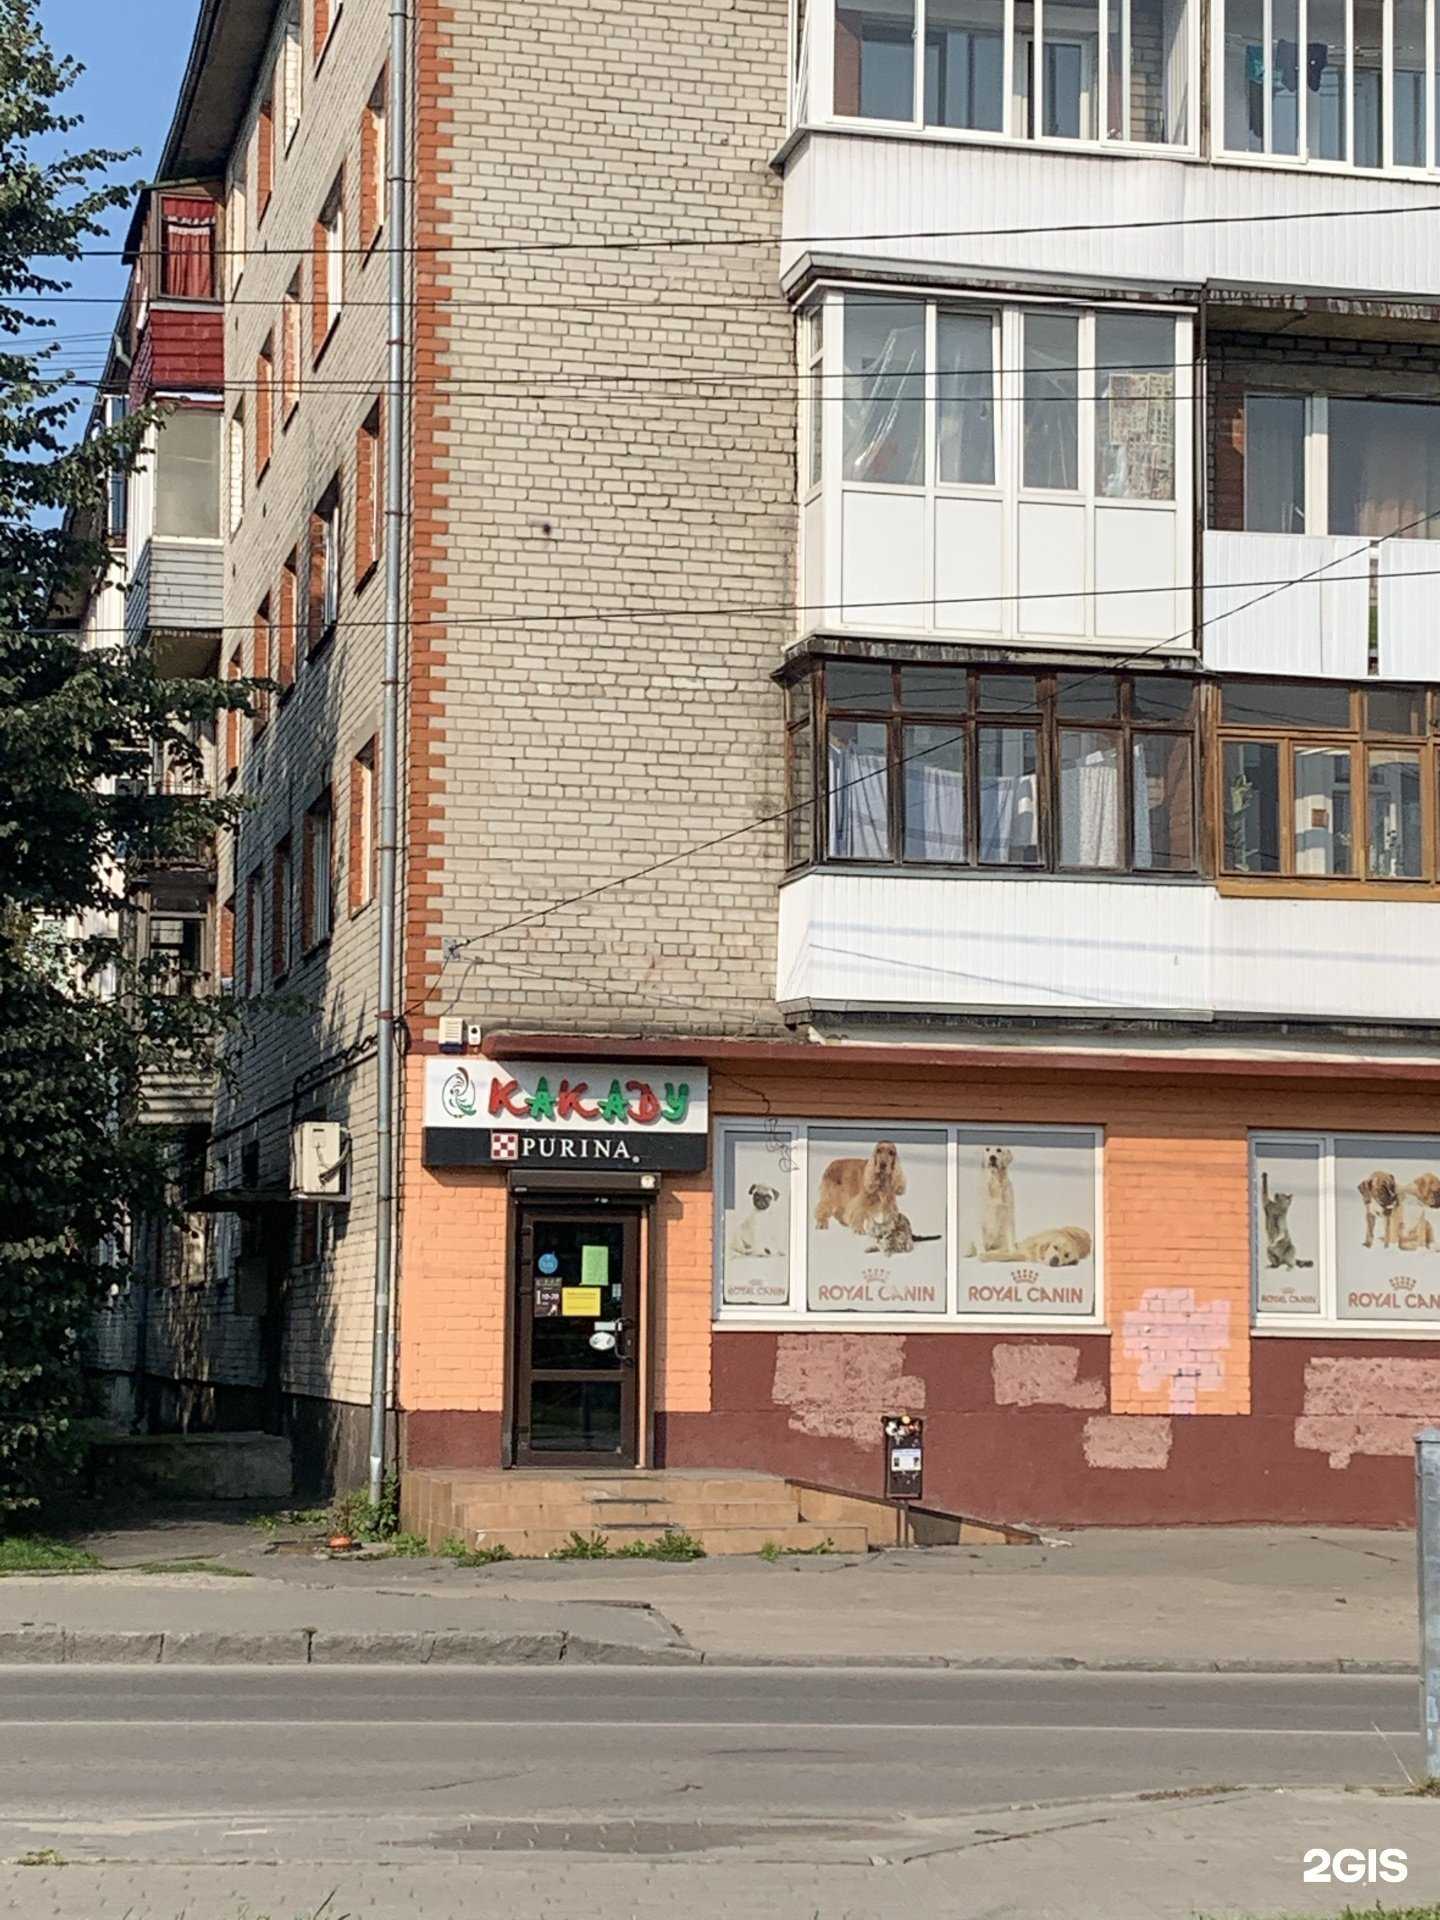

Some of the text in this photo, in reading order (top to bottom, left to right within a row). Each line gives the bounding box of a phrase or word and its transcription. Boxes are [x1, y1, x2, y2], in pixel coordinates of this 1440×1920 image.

[521, 1137, 632, 1158] PURINA
[818, 1285, 874, 1301] ROYAL
[968, 1286, 1084, 1303] ROYAL CANIN
[1348, 1292, 1402, 1309] ROYAL
